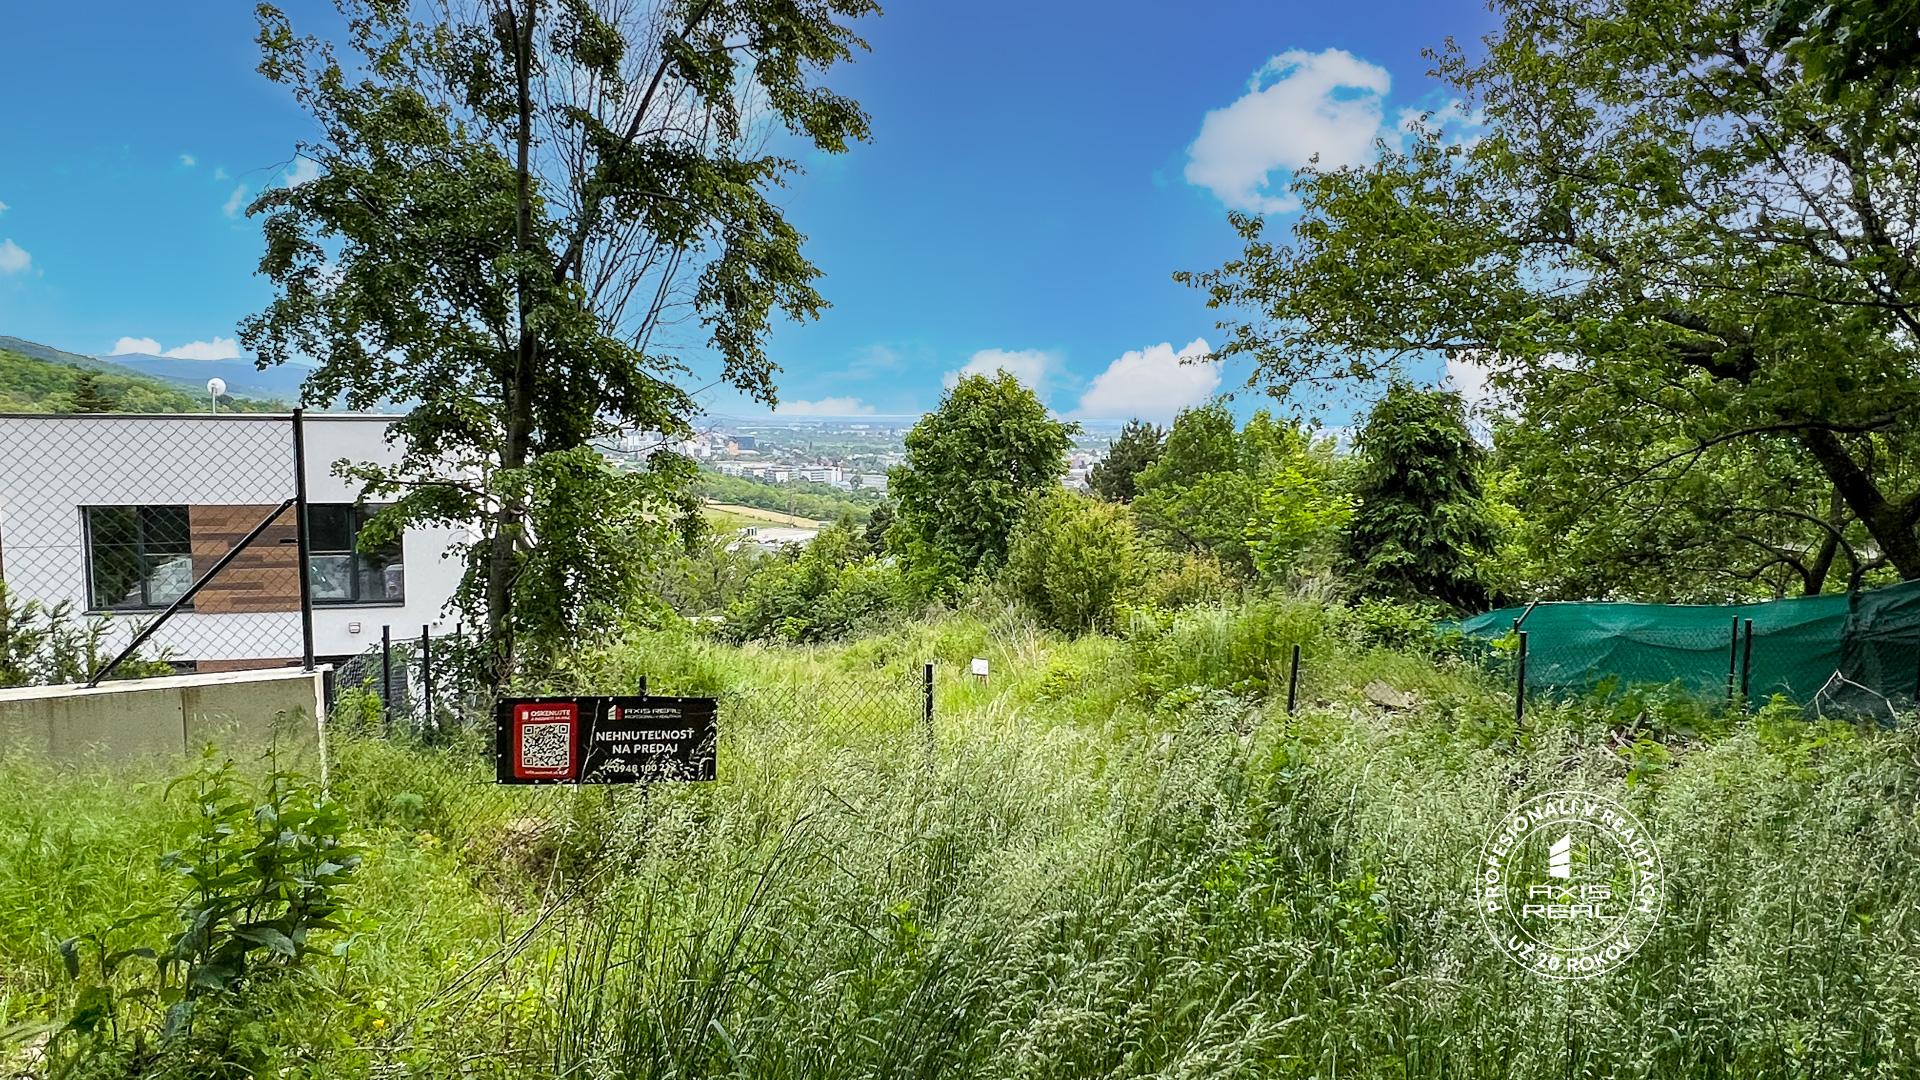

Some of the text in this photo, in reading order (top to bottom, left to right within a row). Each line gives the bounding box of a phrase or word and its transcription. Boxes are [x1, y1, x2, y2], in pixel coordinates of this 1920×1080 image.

[596, 727, 694, 741] NEHNUTEĽNOSŤ
[612, 743, 679, 754] NA PREDAJ
[613, 764, 638, 773] 0948
[640, 764, 657, 772] 100
